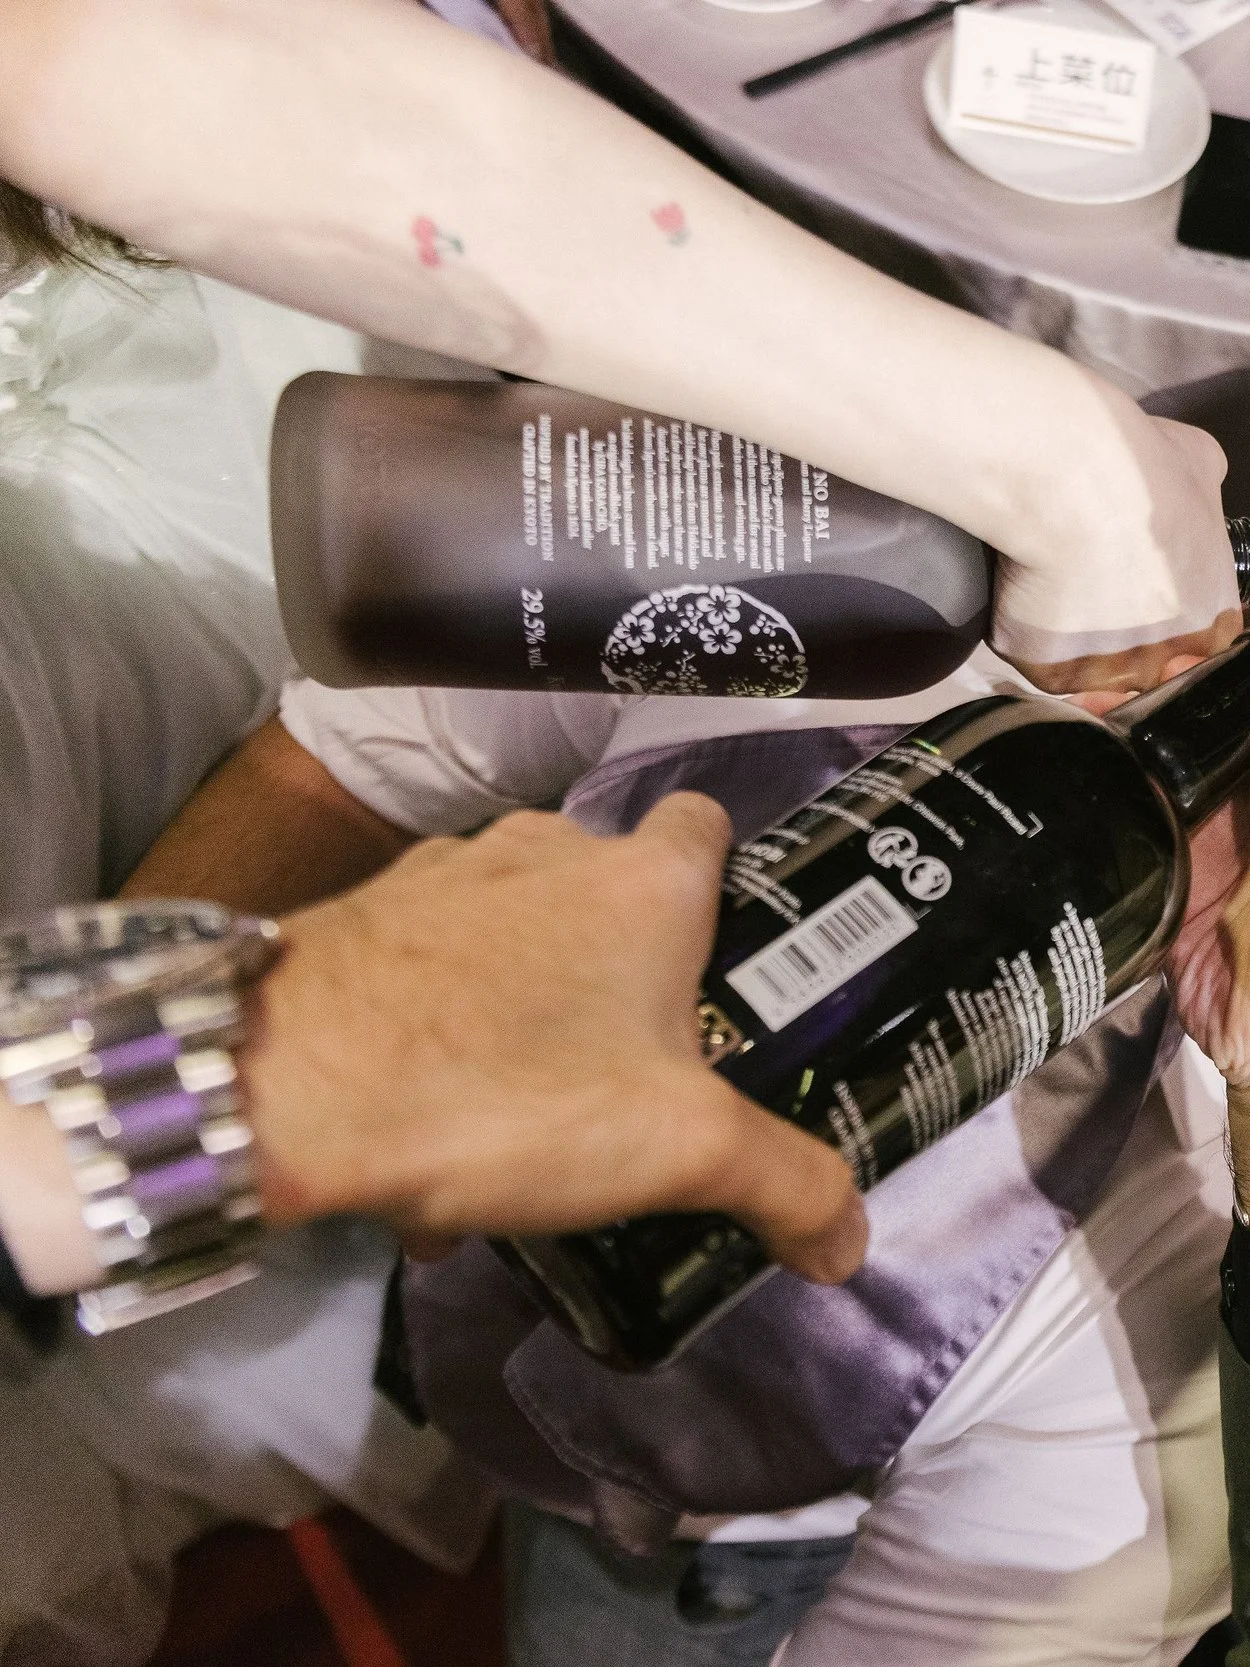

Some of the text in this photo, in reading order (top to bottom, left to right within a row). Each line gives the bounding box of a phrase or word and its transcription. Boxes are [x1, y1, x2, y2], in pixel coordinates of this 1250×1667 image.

[671, 454, 682, 473] short
[696, 460, 709, 484] plums
[711, 452, 723, 468] peak
[735, 464, 744, 478] our
[747, 459, 757, 477] then
[523, 424, 537, 546] CRAFTED IN KYOTO
[538, 415, 554, 562] INSPIRED BY TRADITION
[565, 478, 578, 503] Kyoto
[608, 475, 620, 520] woodblock
[686, 472, 697, 501] berries
[700, 486, 708, 499] are
[714, 471, 724, 512] extraction
[802, 478, 811, 495] and
[581, 481, 593, 521] karakami
[623, 489, 634, 511] been
[645, 480, 658, 539] northernmost
[748, 478, 759, 522] macerated
[761, 486, 772, 524] Tanaka's
[772, 472, 785, 526] Kyoto-grown
[802, 497, 812, 523] Berry
[813, 472, 829, 540] NO BAI
[660, 510, 671, 530] with
[672, 503, 682, 524] once
[687, 503, 698, 524] from
[700, 501, 711, 538] removed
[734, 480, 746, 545] award-winning
[583, 521, 594, 549] atelier
[608, 520, 621, 546] print
[624, 513, 635, 545] created
[674, 527, 685, 548] these
[714, 524, 726, 560] reached,
[750, 524, 760, 536] for
[762, 526, 773, 545] farm
[772, 528, 787, 555] plums
[687, 525, 699, 570] Hokkaido
[701, 540, 712, 557] and
[751, 538, 761, 569] several
[803, 524, 813, 563] Liqueur
[625, 546, 636, 568] from
[675, 550, 684, 565] are
[763, 548, 774, 572] south
[776, 557, 785, 571] are
[520, 587, 548, 669] 29.5% vol.
